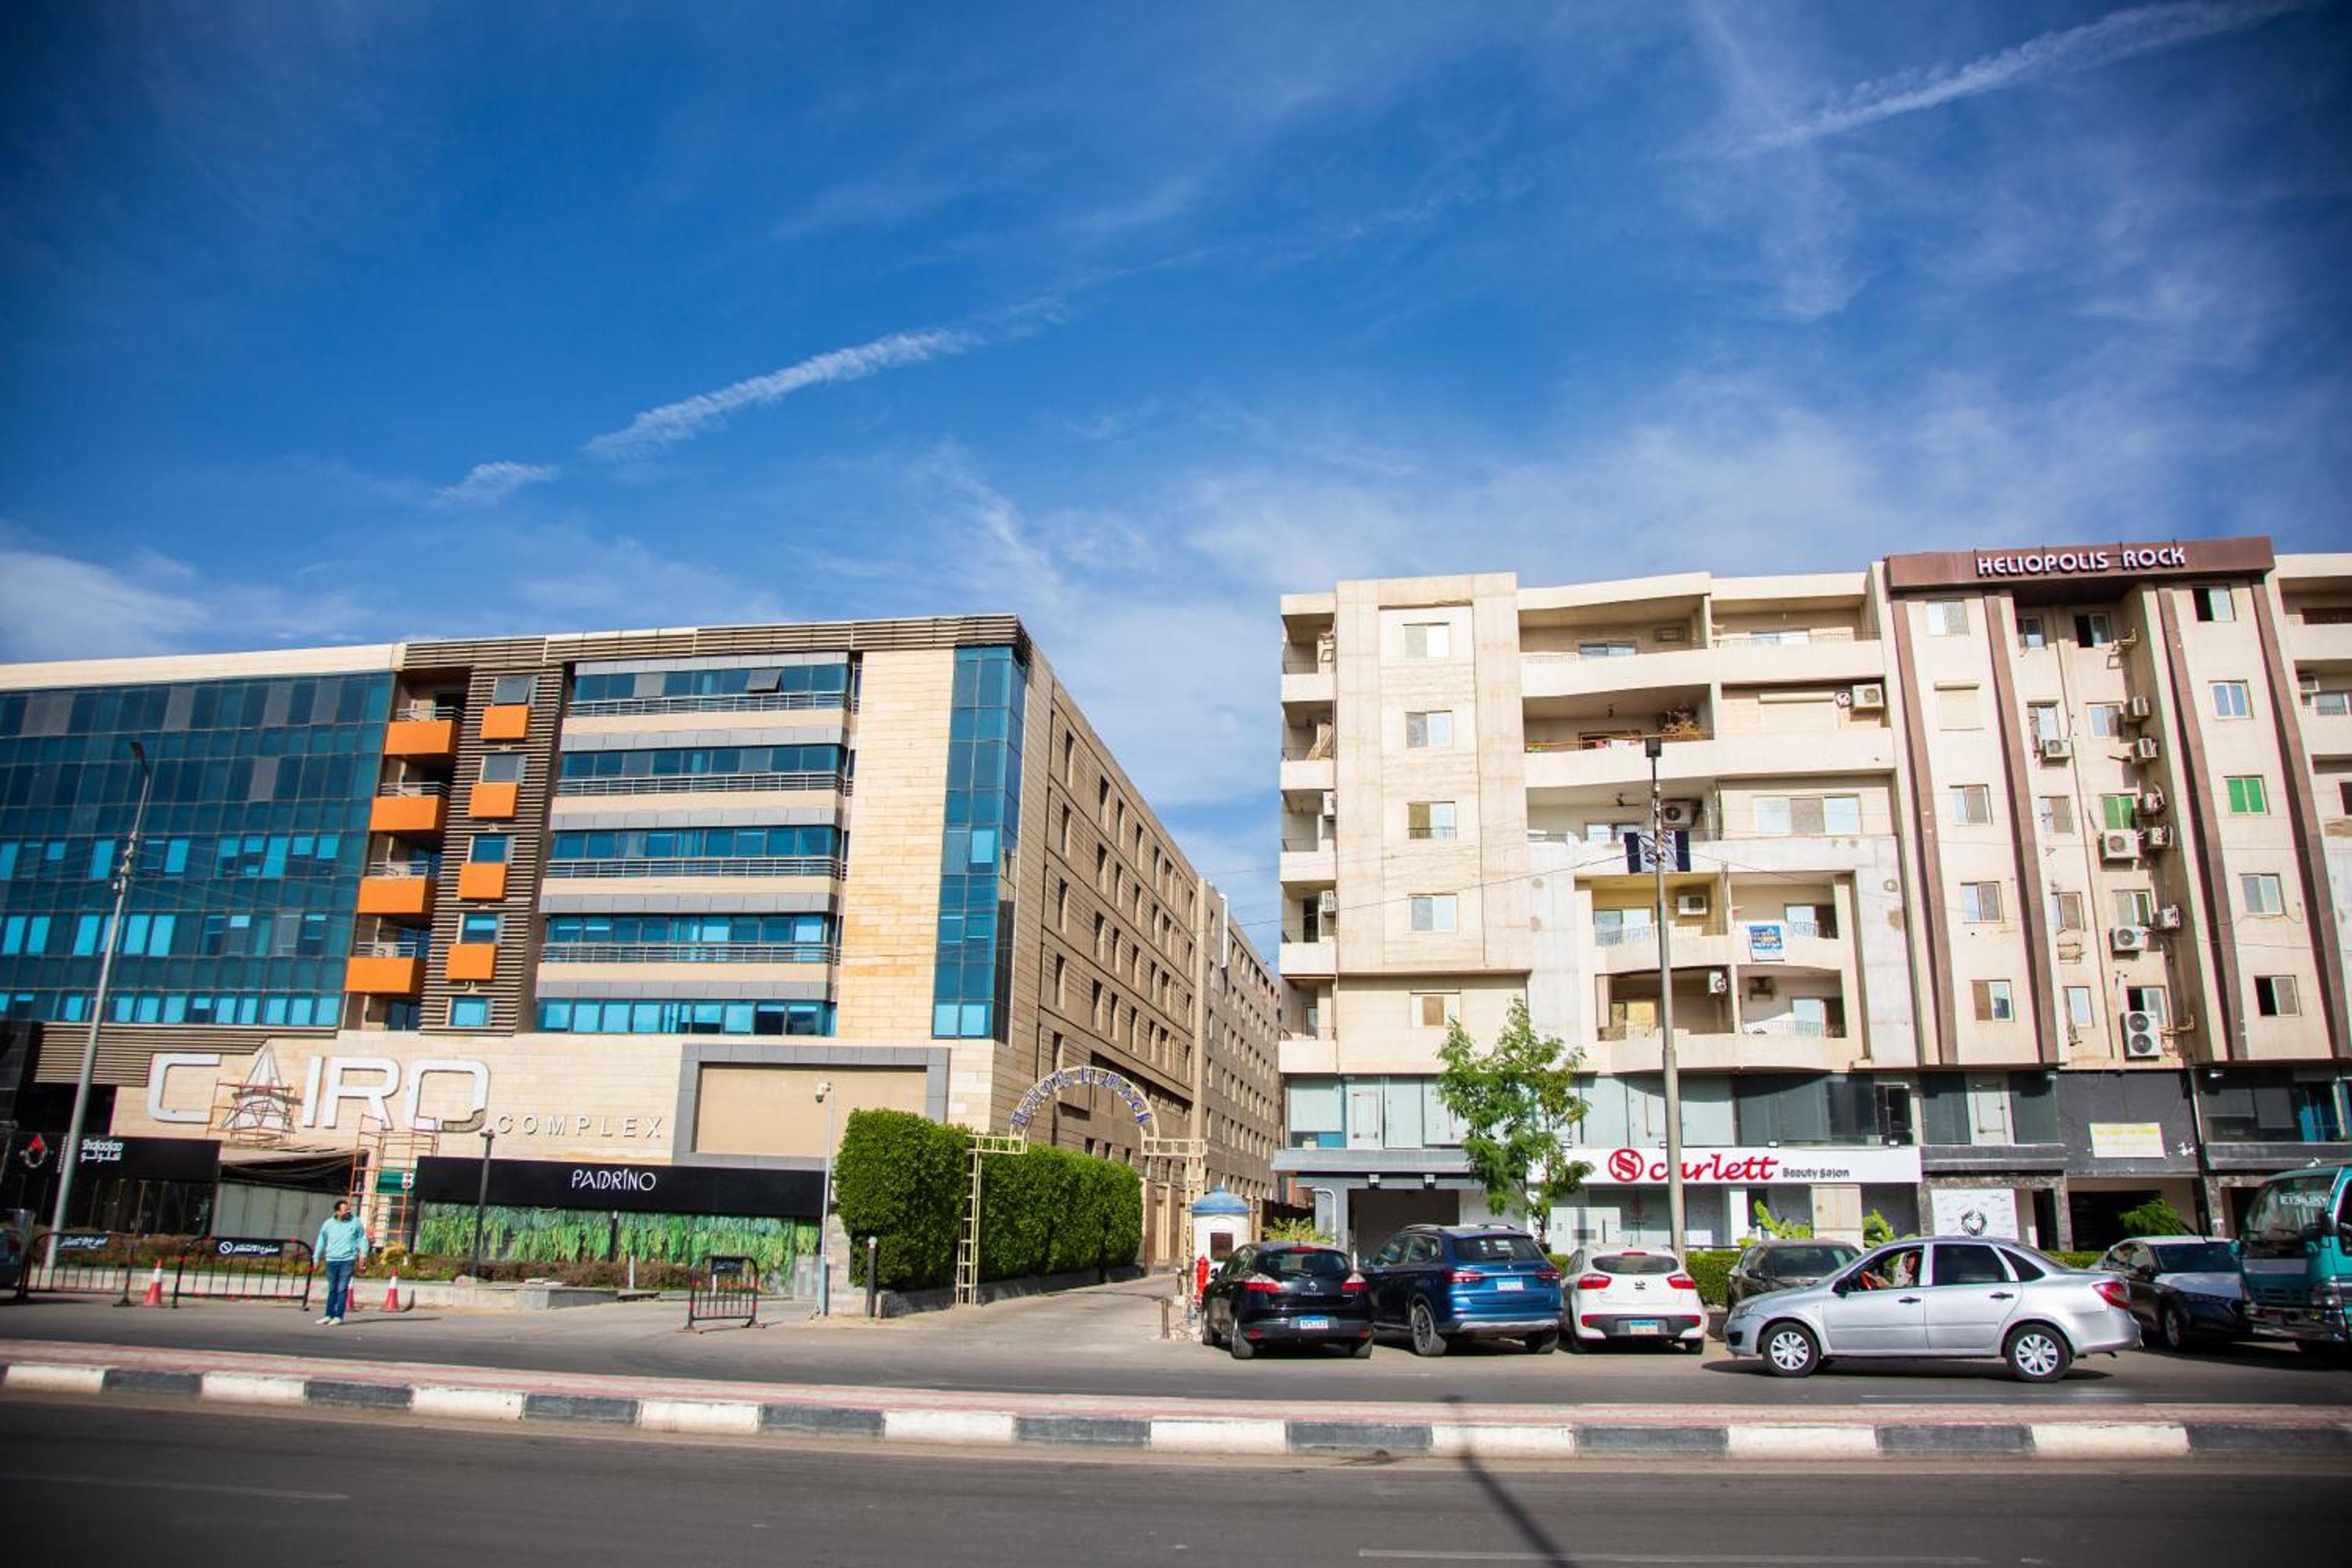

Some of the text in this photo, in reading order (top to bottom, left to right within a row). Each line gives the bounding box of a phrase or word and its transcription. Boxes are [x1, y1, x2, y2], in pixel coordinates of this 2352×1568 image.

[1977, 546, 2186, 576] HELIOPOLIS ROCK
[147, 1041, 492, 1134] CAIRO
[497, 1115, 663, 1138] COMPLEX
